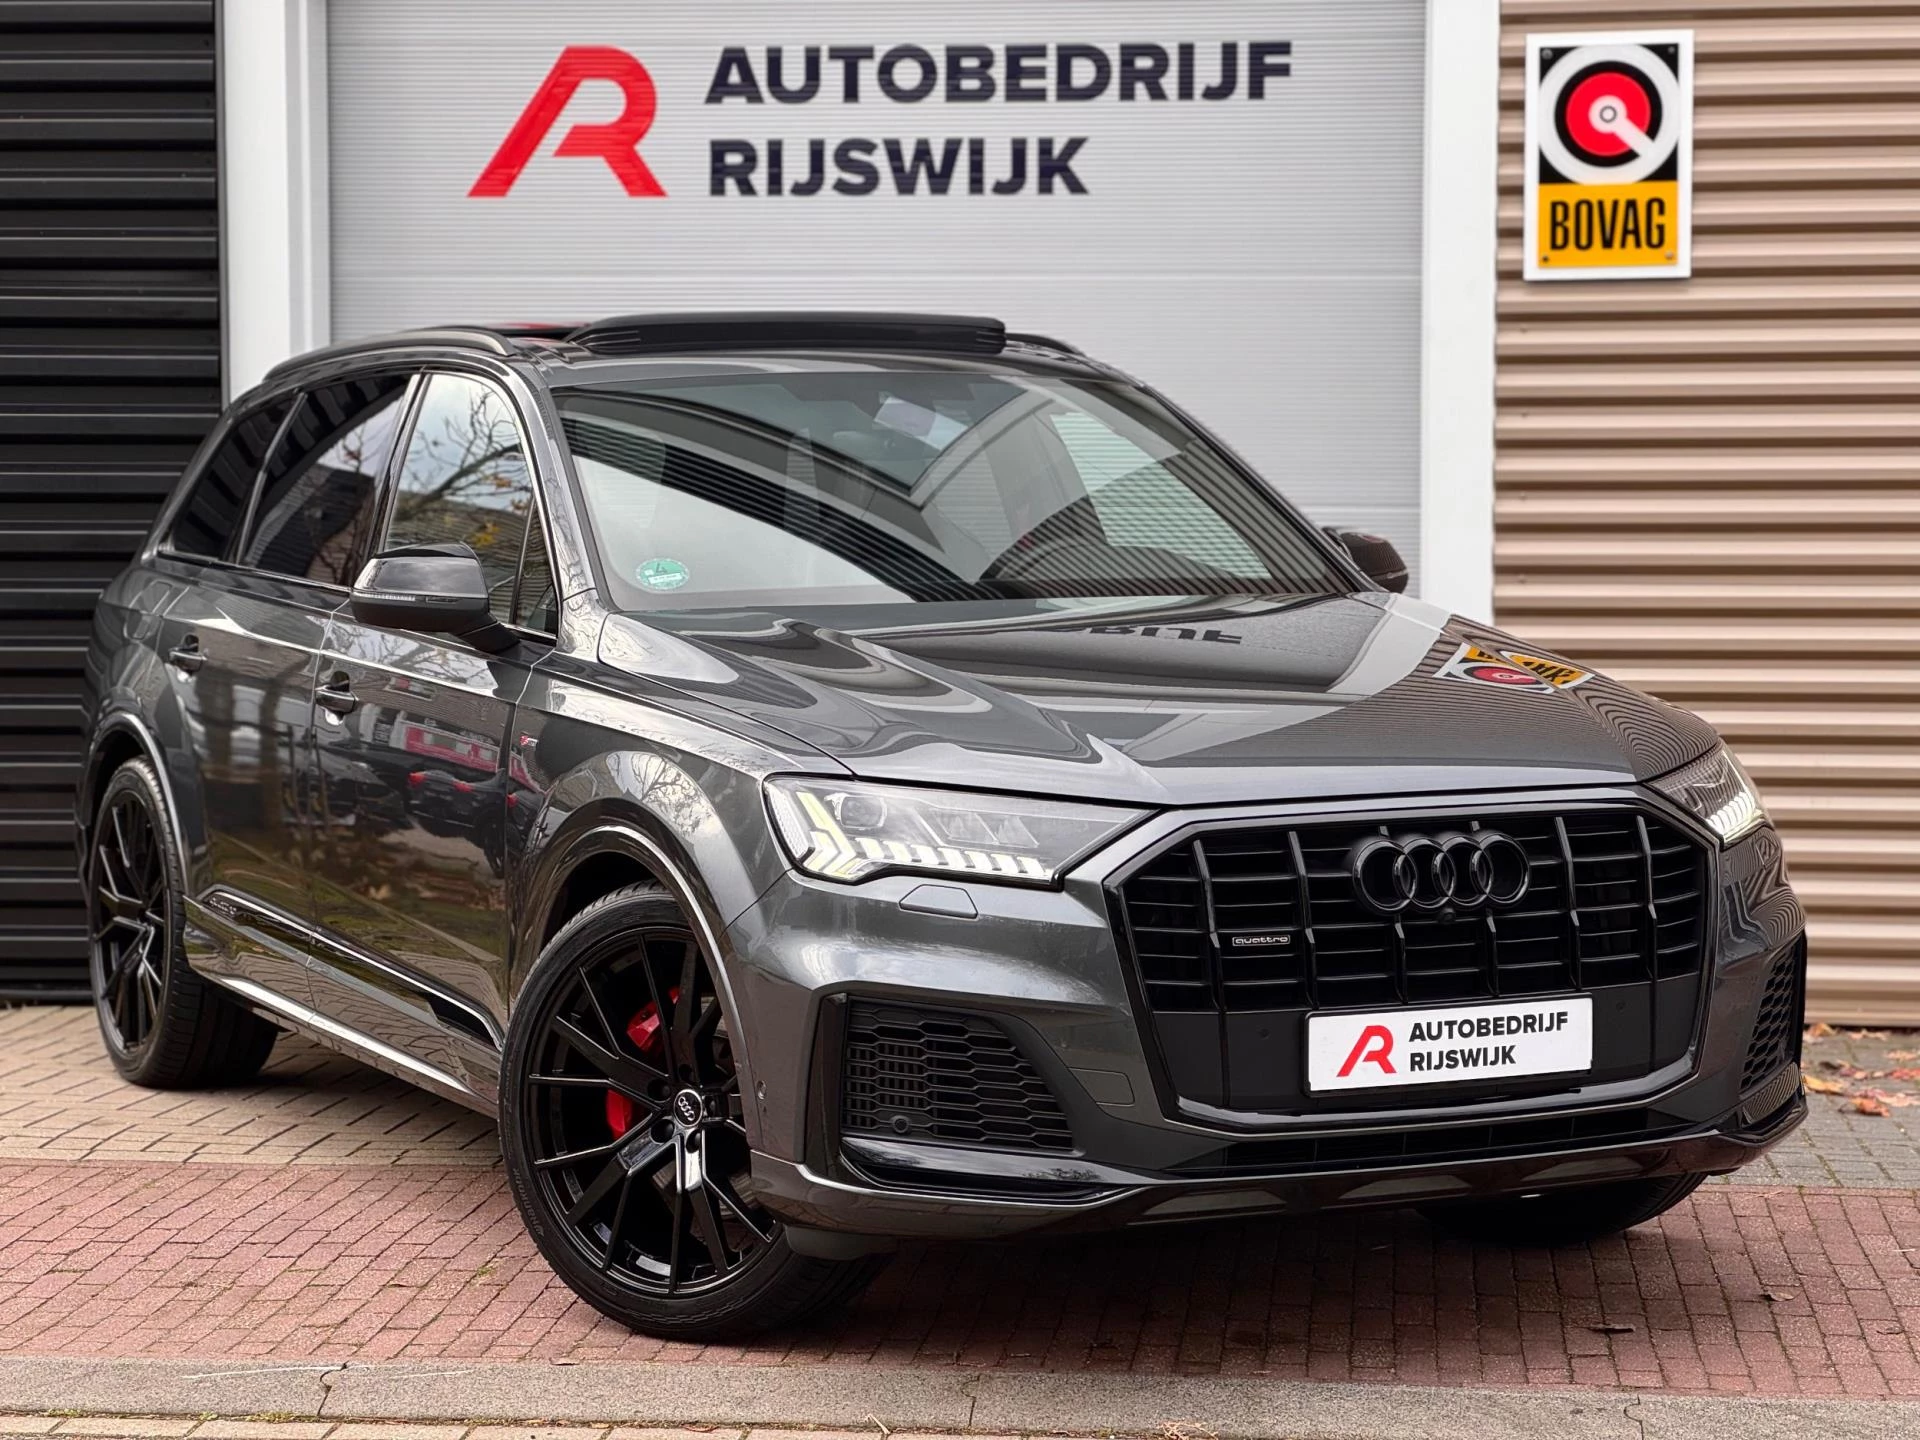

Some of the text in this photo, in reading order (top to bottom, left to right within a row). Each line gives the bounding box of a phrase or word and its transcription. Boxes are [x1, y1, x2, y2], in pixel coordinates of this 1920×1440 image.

[704, 41, 1292, 104] AUTOBEDRIJF
[708, 137, 1090, 197] RIJSWIJK
[1550, 197, 1666, 251] BOVAG
[1234, 935, 1290, 945] quattro
[1408, 1011, 1569, 1042] AUTOBEDRIJF
[1409, 1045, 1516, 1072] RIJSWIJK
